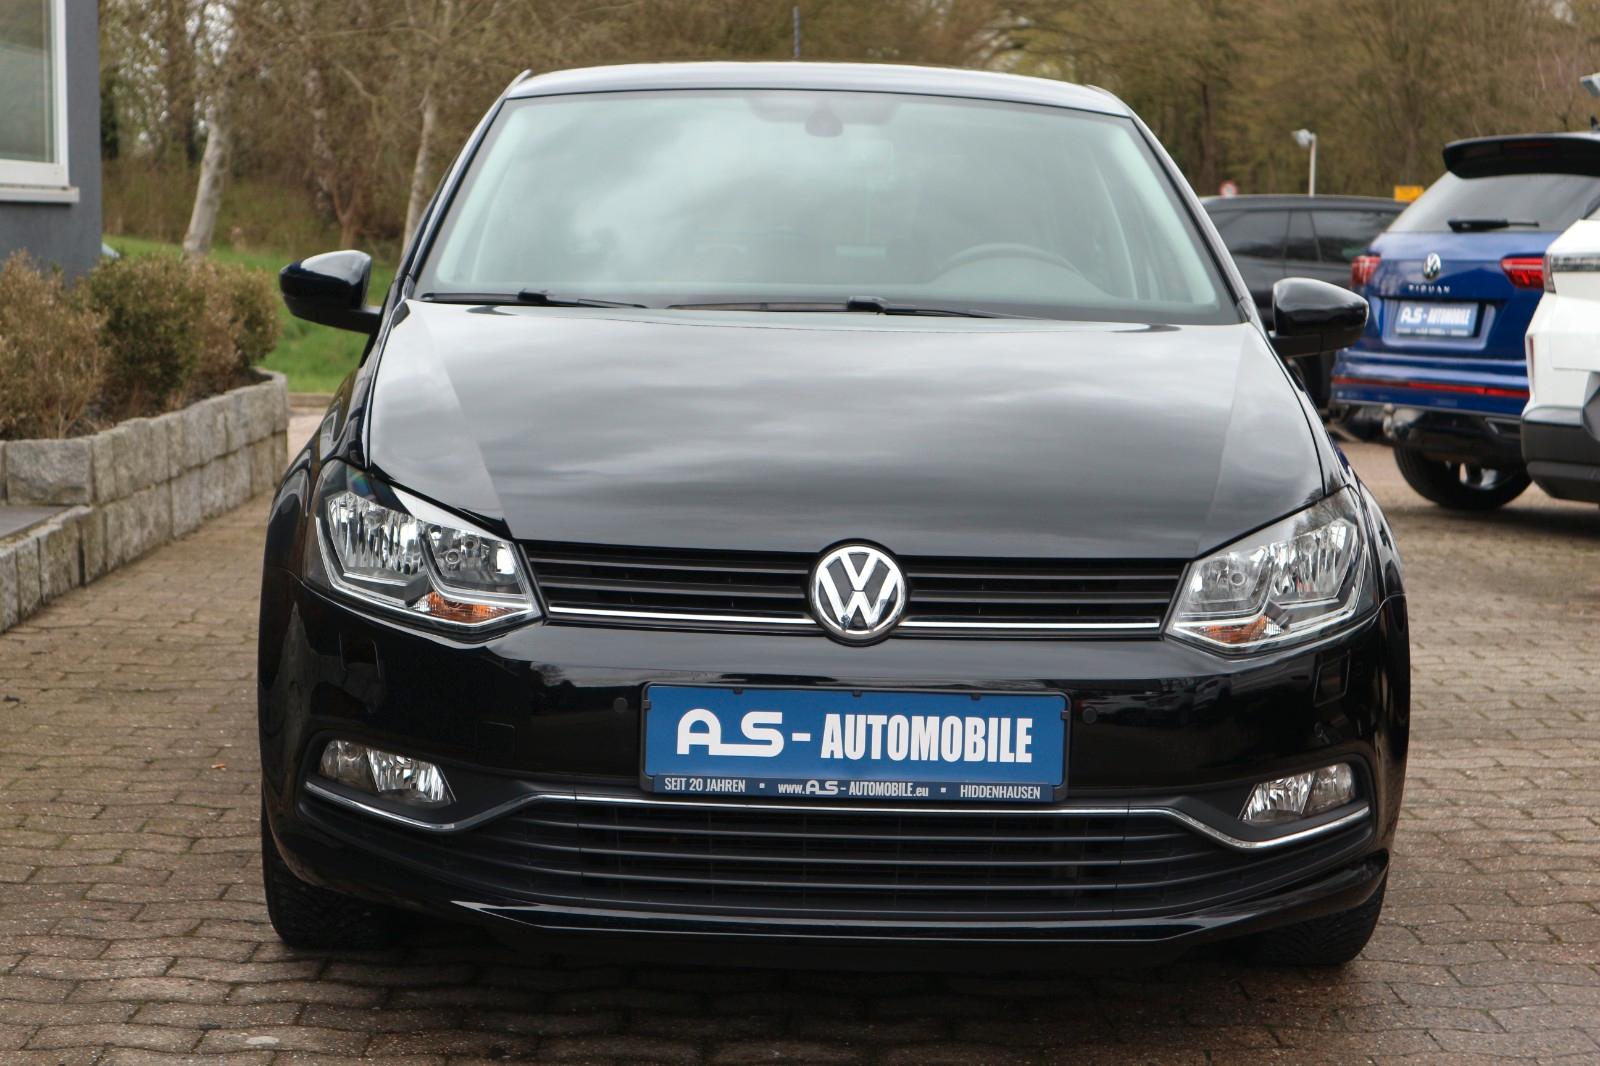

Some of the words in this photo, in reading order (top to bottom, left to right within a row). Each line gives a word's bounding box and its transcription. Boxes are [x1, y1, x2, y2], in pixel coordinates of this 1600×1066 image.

[821, 713, 1032, 763] AUTOMOBILE
[664, 777, 687, 791] SEIT
[689, 778, 703, 792] 20
[705, 779, 746, 793] JAHREN
[960, 785, 1041, 799] HIDDENHAUSEN
